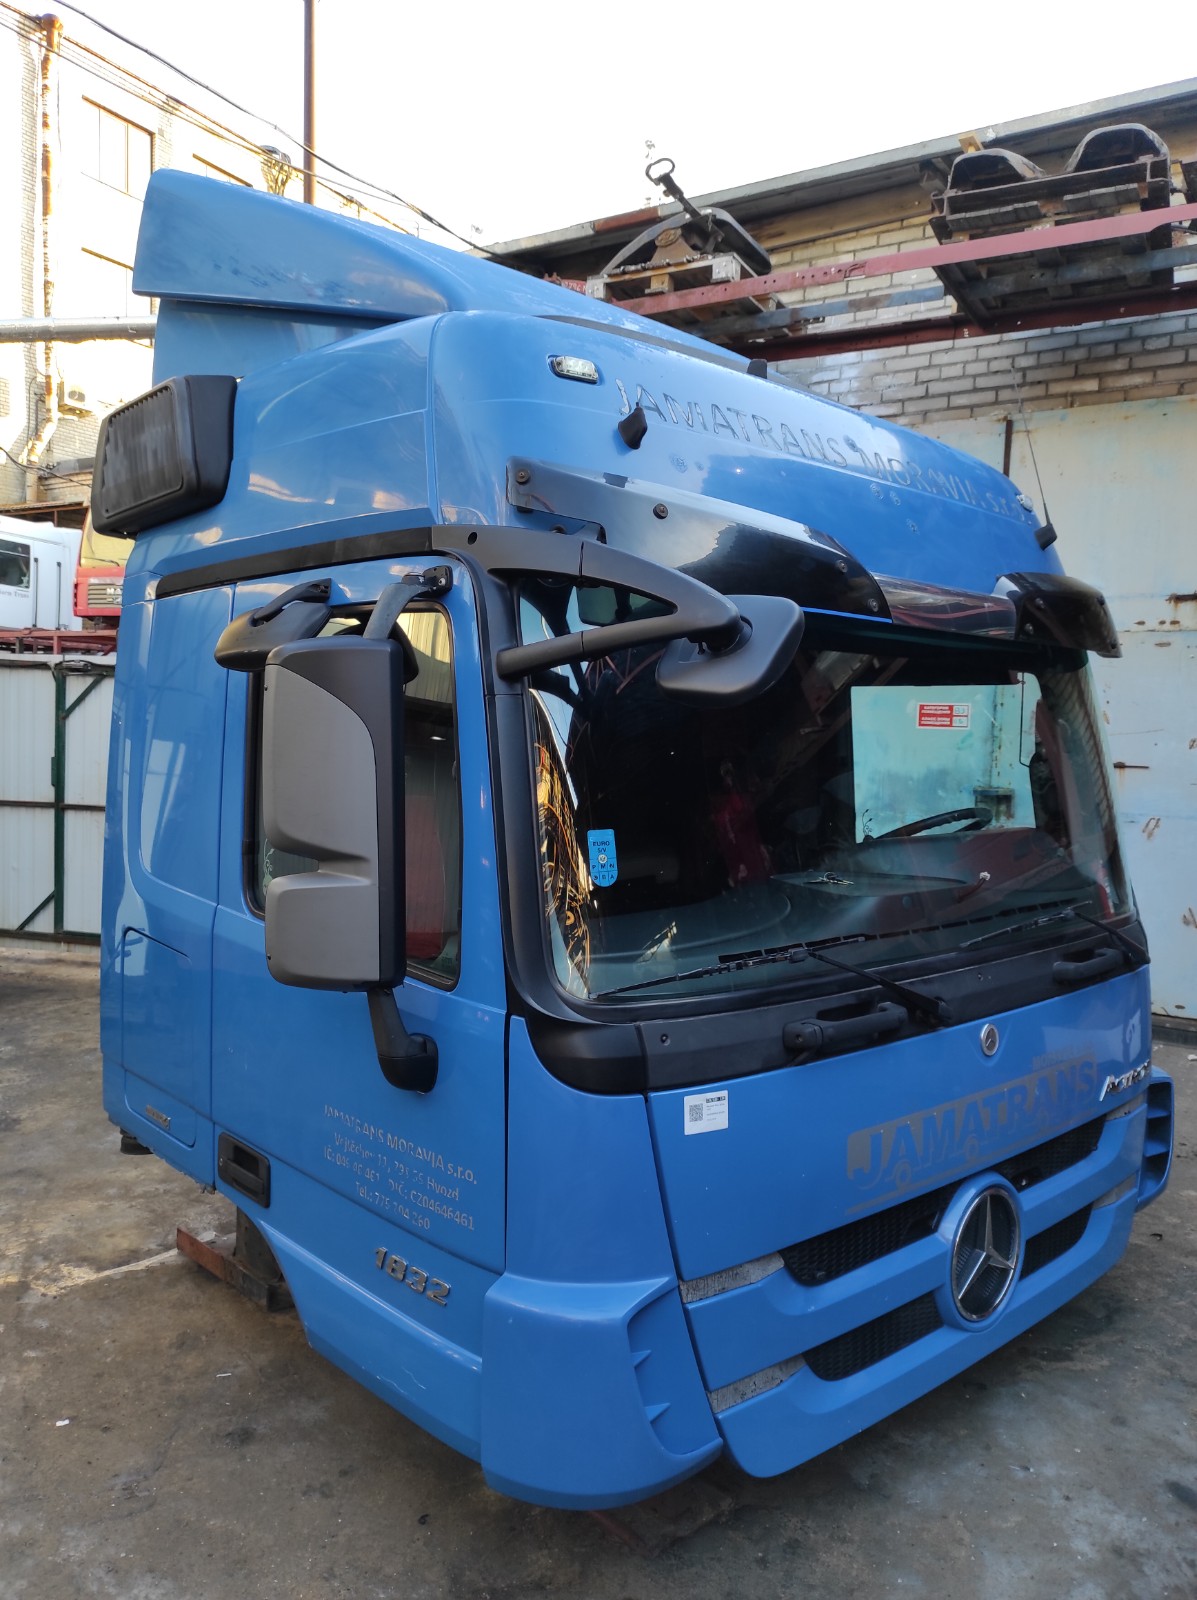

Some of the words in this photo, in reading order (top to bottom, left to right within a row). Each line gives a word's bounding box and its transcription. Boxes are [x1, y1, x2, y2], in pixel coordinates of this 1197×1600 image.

[848, 1058, 1098, 1190] JAMATRANS
[387, 1132, 445, 1172] MORAVIA
[447, 1163, 477, 1185] s.r.o.
[375, 1247, 451, 1307] 1832
